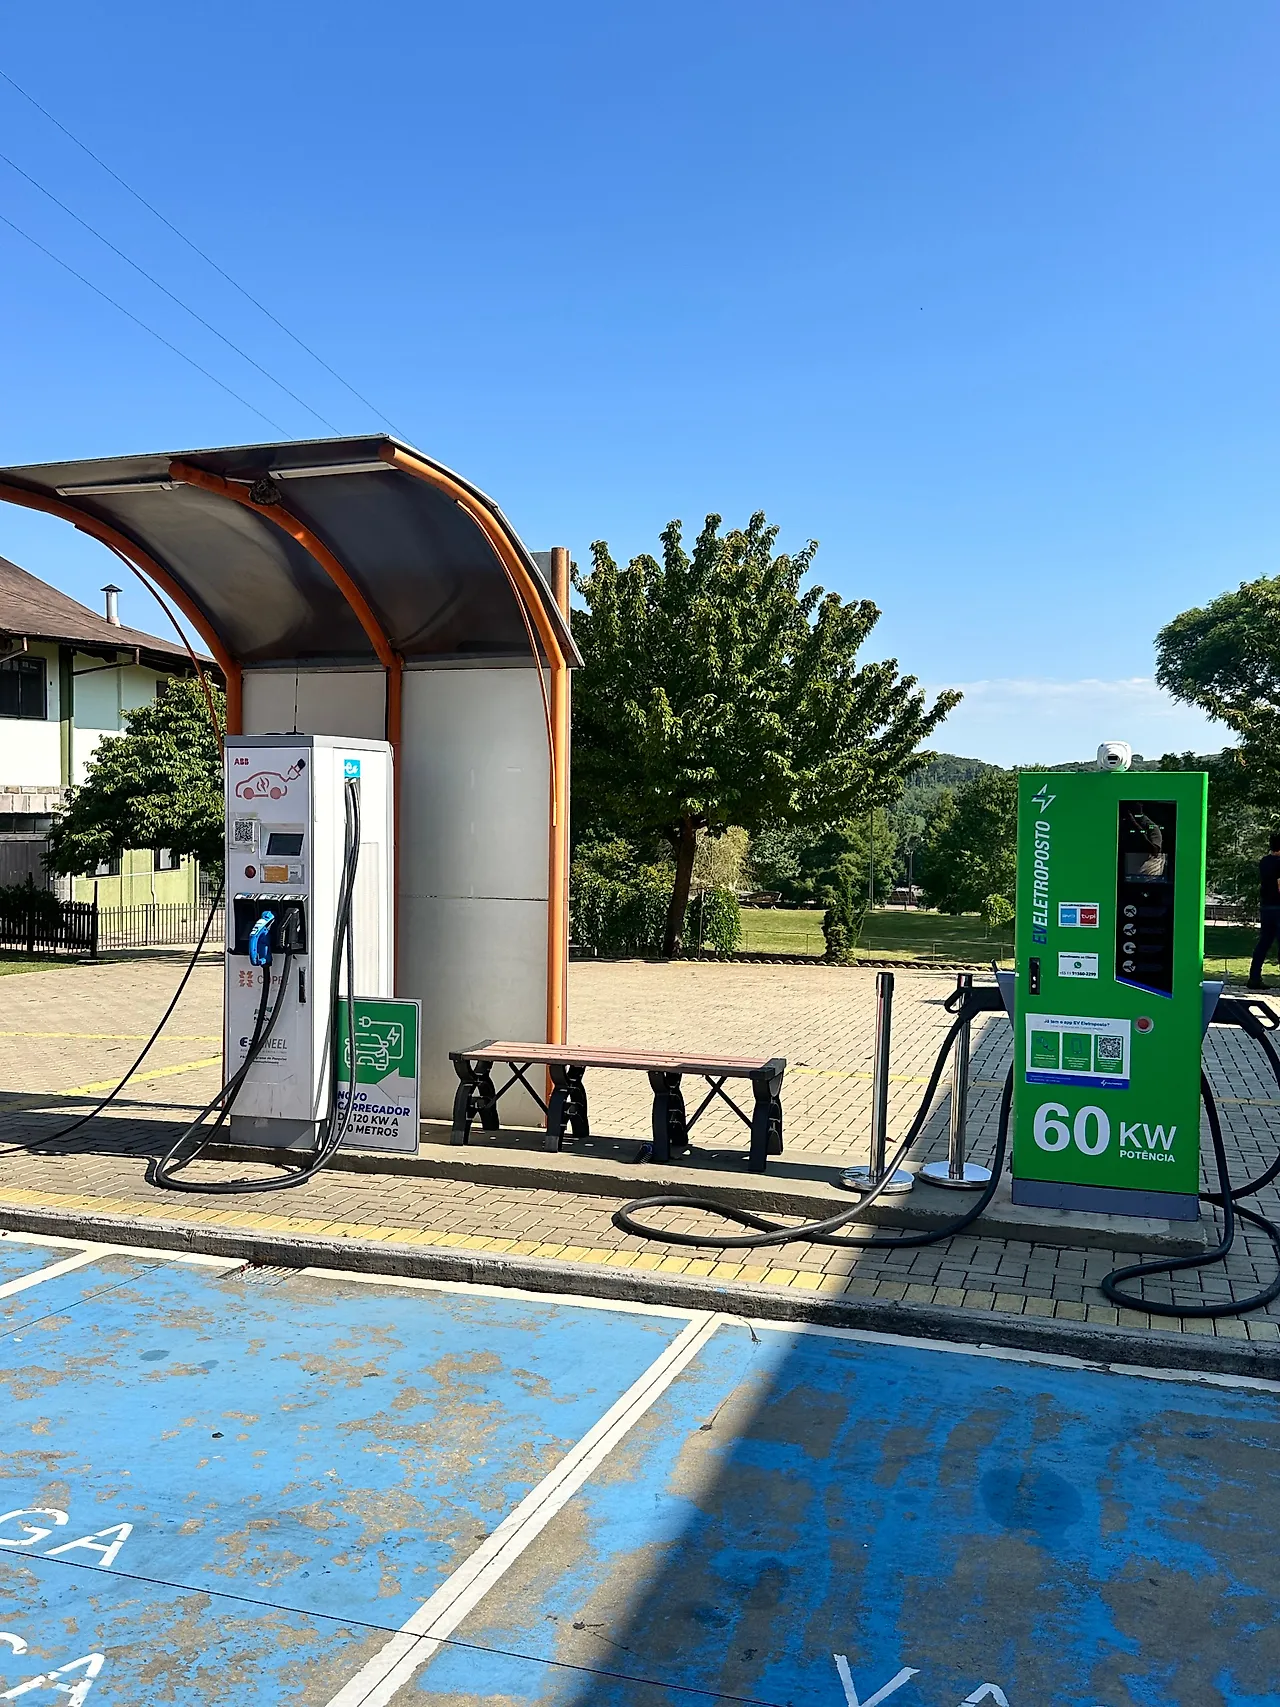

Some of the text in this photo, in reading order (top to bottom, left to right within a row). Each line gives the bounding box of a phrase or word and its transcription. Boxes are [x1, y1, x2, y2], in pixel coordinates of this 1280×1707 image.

[234, 757, 249, 766] ABB
[262, 1038, 288, 1049] NEEL
[353, 1113, 369, 1123] 120
[370, 1115, 390, 1126] KW
[390, 1117, 399, 1126] A
[337, 1122, 399, 1137] 10 METROS
[1033, 1102, 1178, 1156] 60 KW
[1119, 1150, 1176, 1163] POTÊNCIA
